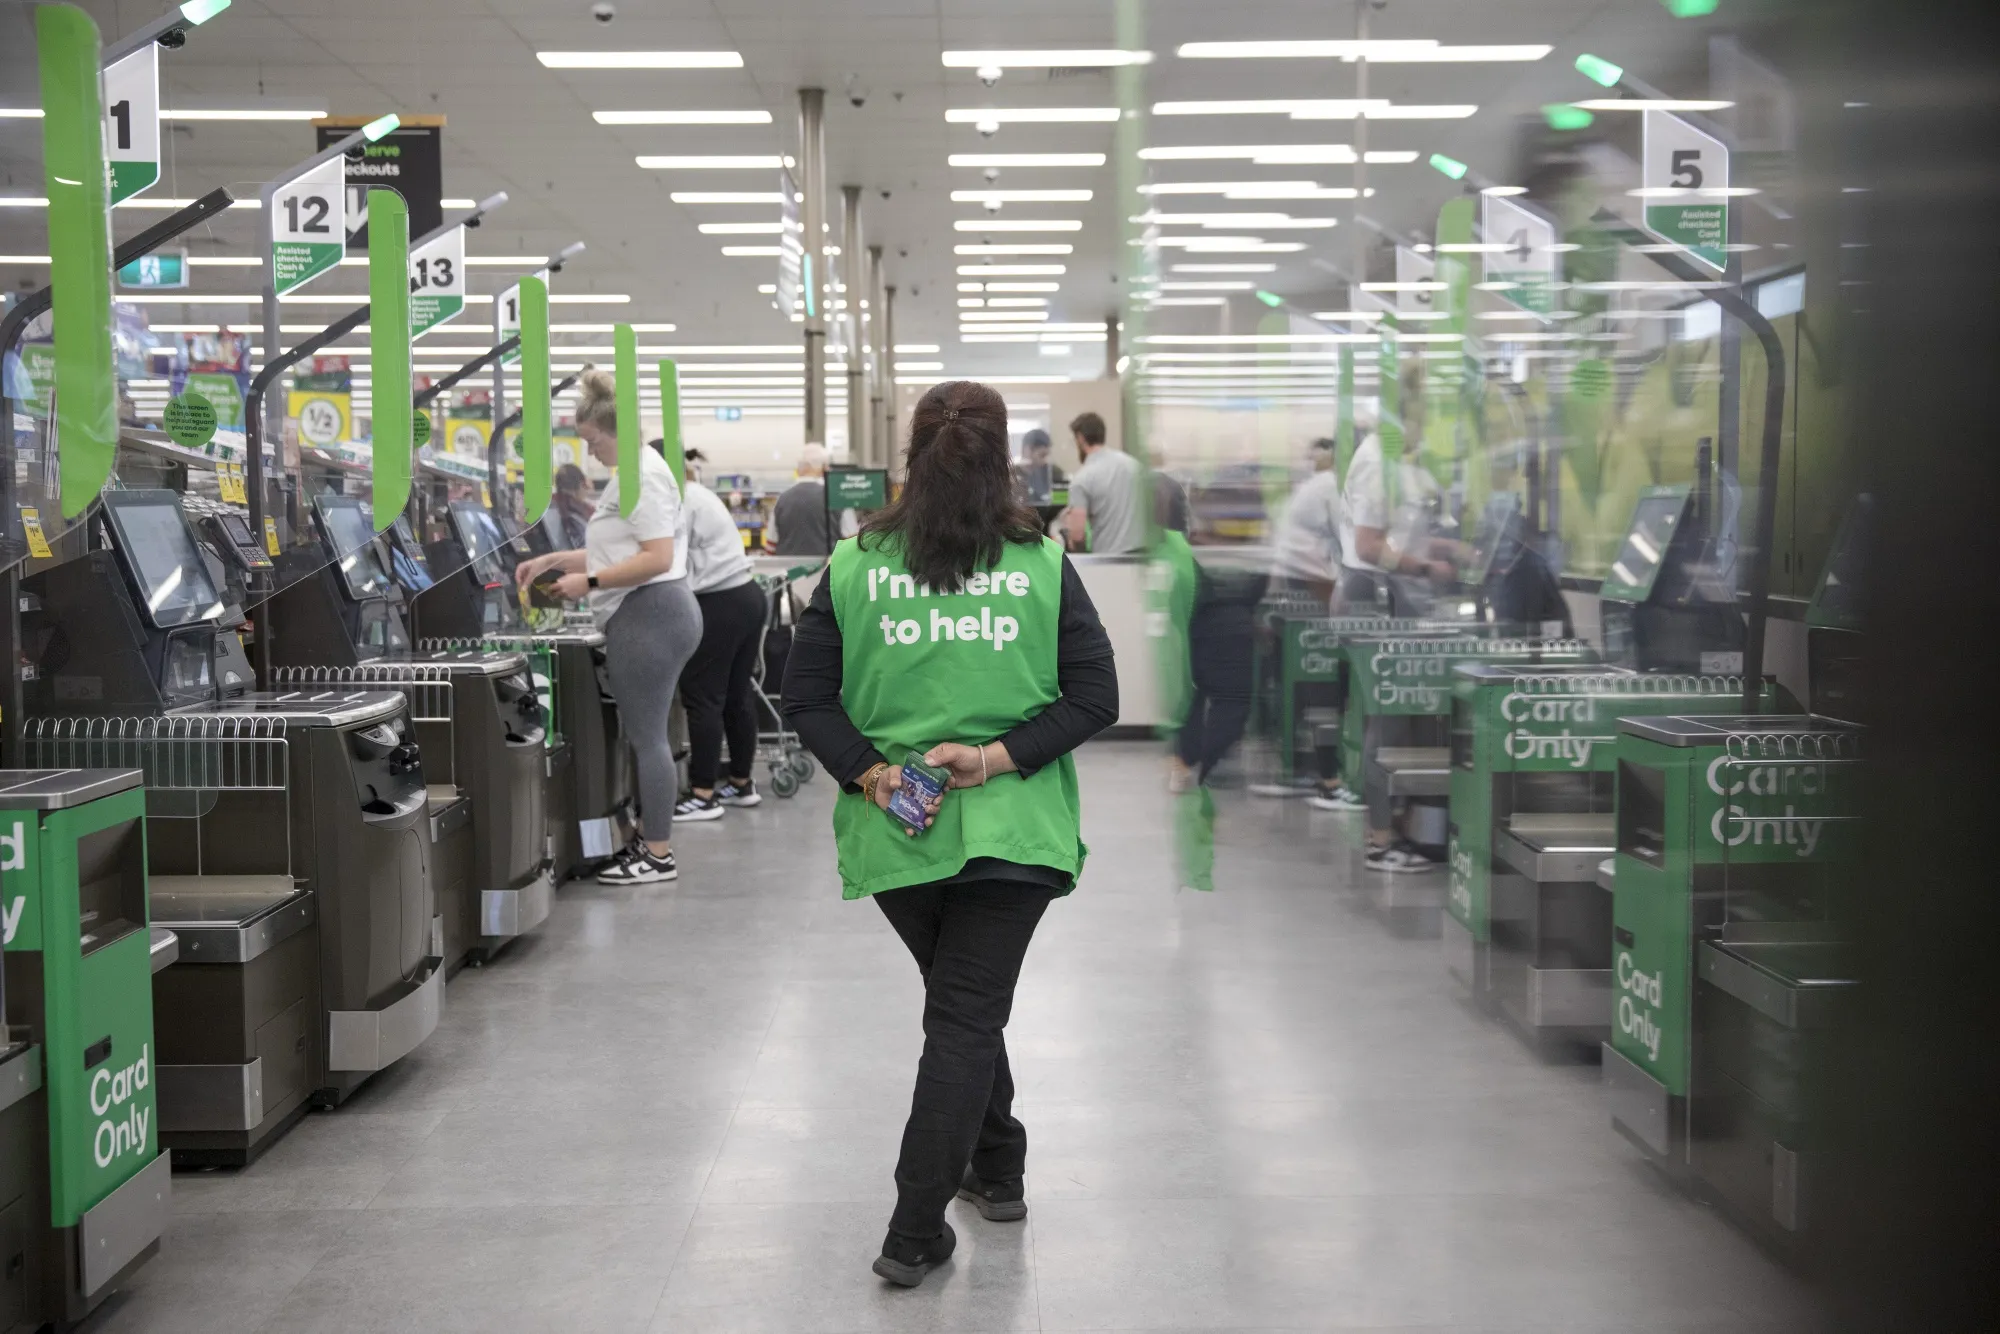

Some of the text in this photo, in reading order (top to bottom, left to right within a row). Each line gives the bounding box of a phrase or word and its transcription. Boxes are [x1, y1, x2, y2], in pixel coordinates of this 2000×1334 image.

[344, 161, 401, 177] eckouts
[1669, 149, 1704, 191] 5
[283, 195, 330, 233] 12
[1677, 219, 1721, 230] checkout
[1681, 209, 1722, 219] Assisted
[1504, 227, 1532, 264] 4
[1697, 229, 1721, 239] Card
[276, 246, 312, 256] Assisted
[276, 255, 313, 264] checkout
[276, 263, 305, 272] Cash &
[276, 271, 297, 280] Card
[416, 257, 454, 288] 13
[939, 571, 1030, 598] ere
[879, 606, 1020, 651] to help
[1370, 651, 1446, 677] Card
[1372, 680, 1441, 712] Only
[1501, 691, 1597, 723] Card
[1504, 727, 1592, 768] Only
[1706, 754, 1826, 796] Card
[1710, 804, 1823, 857] Only
[1617, 951, 1663, 1009] Card
[1618, 995, 1662, 1062] Only
[90, 1042, 149, 1117] Card
[94, 1102, 150, 1169] Only
